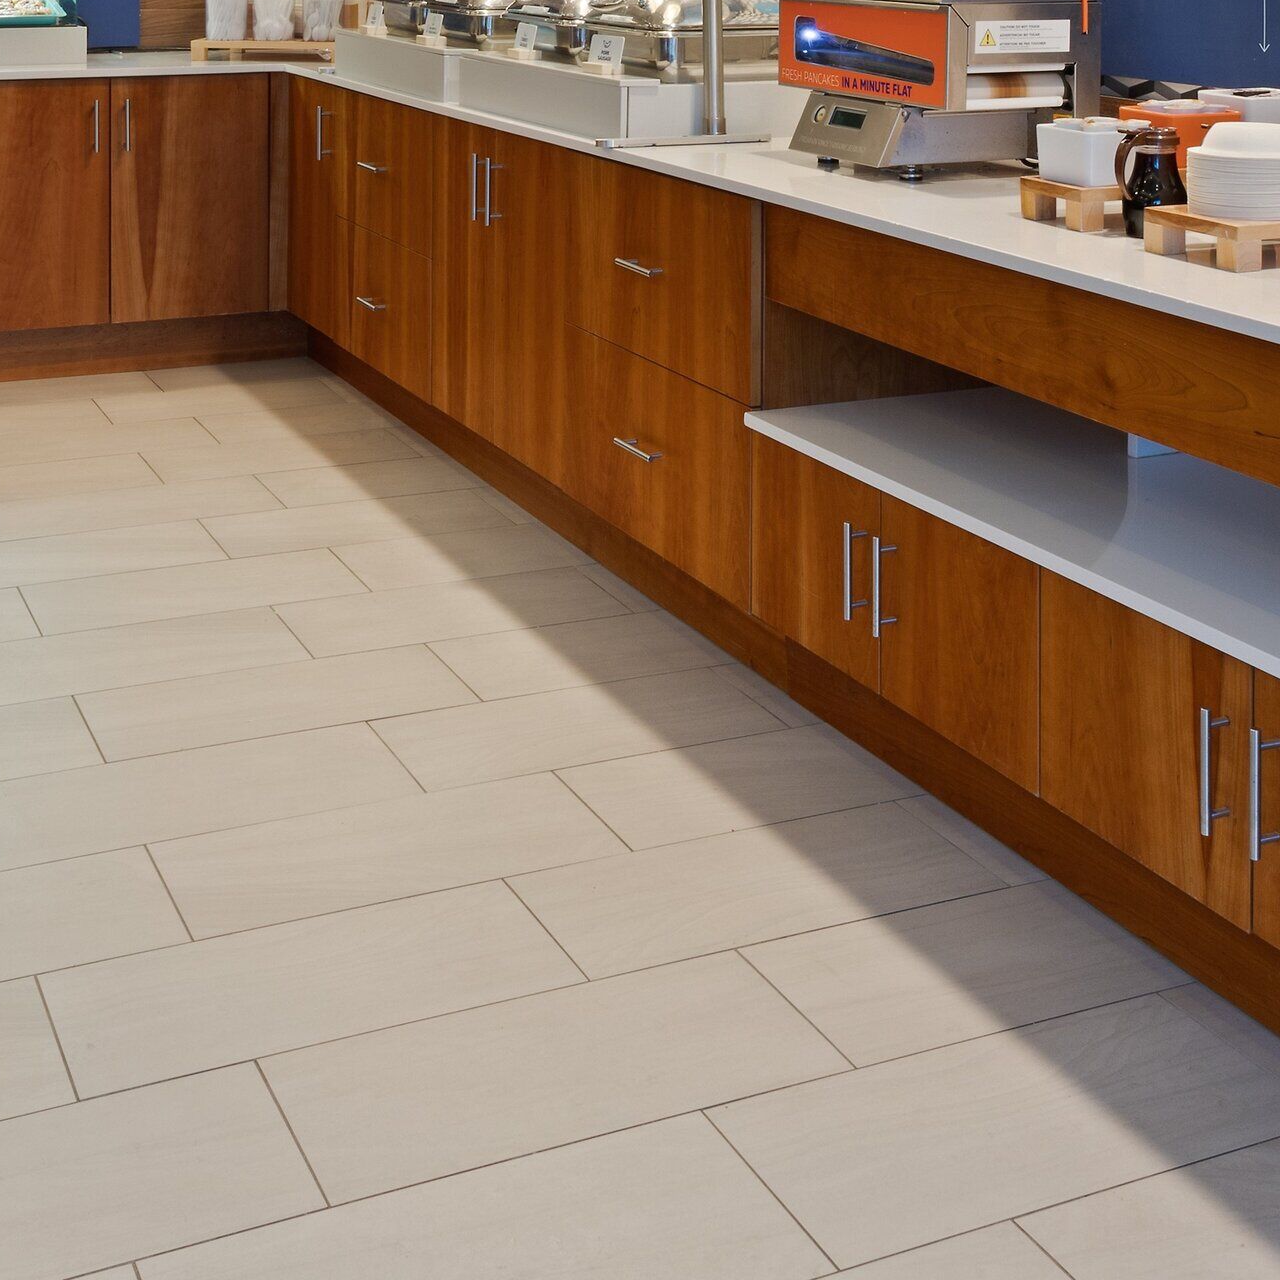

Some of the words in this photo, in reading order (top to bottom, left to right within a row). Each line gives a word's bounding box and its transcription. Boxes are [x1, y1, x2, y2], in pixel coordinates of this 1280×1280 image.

[781, 67, 803, 81] FRESH
[804, 71, 840, 87] PANCAKES
[841, 76, 851, 87] IN
[852, 78, 858, 89] A
[860, 79, 891, 95] MINUTE
[892, 83, 913, 98] FLAT
